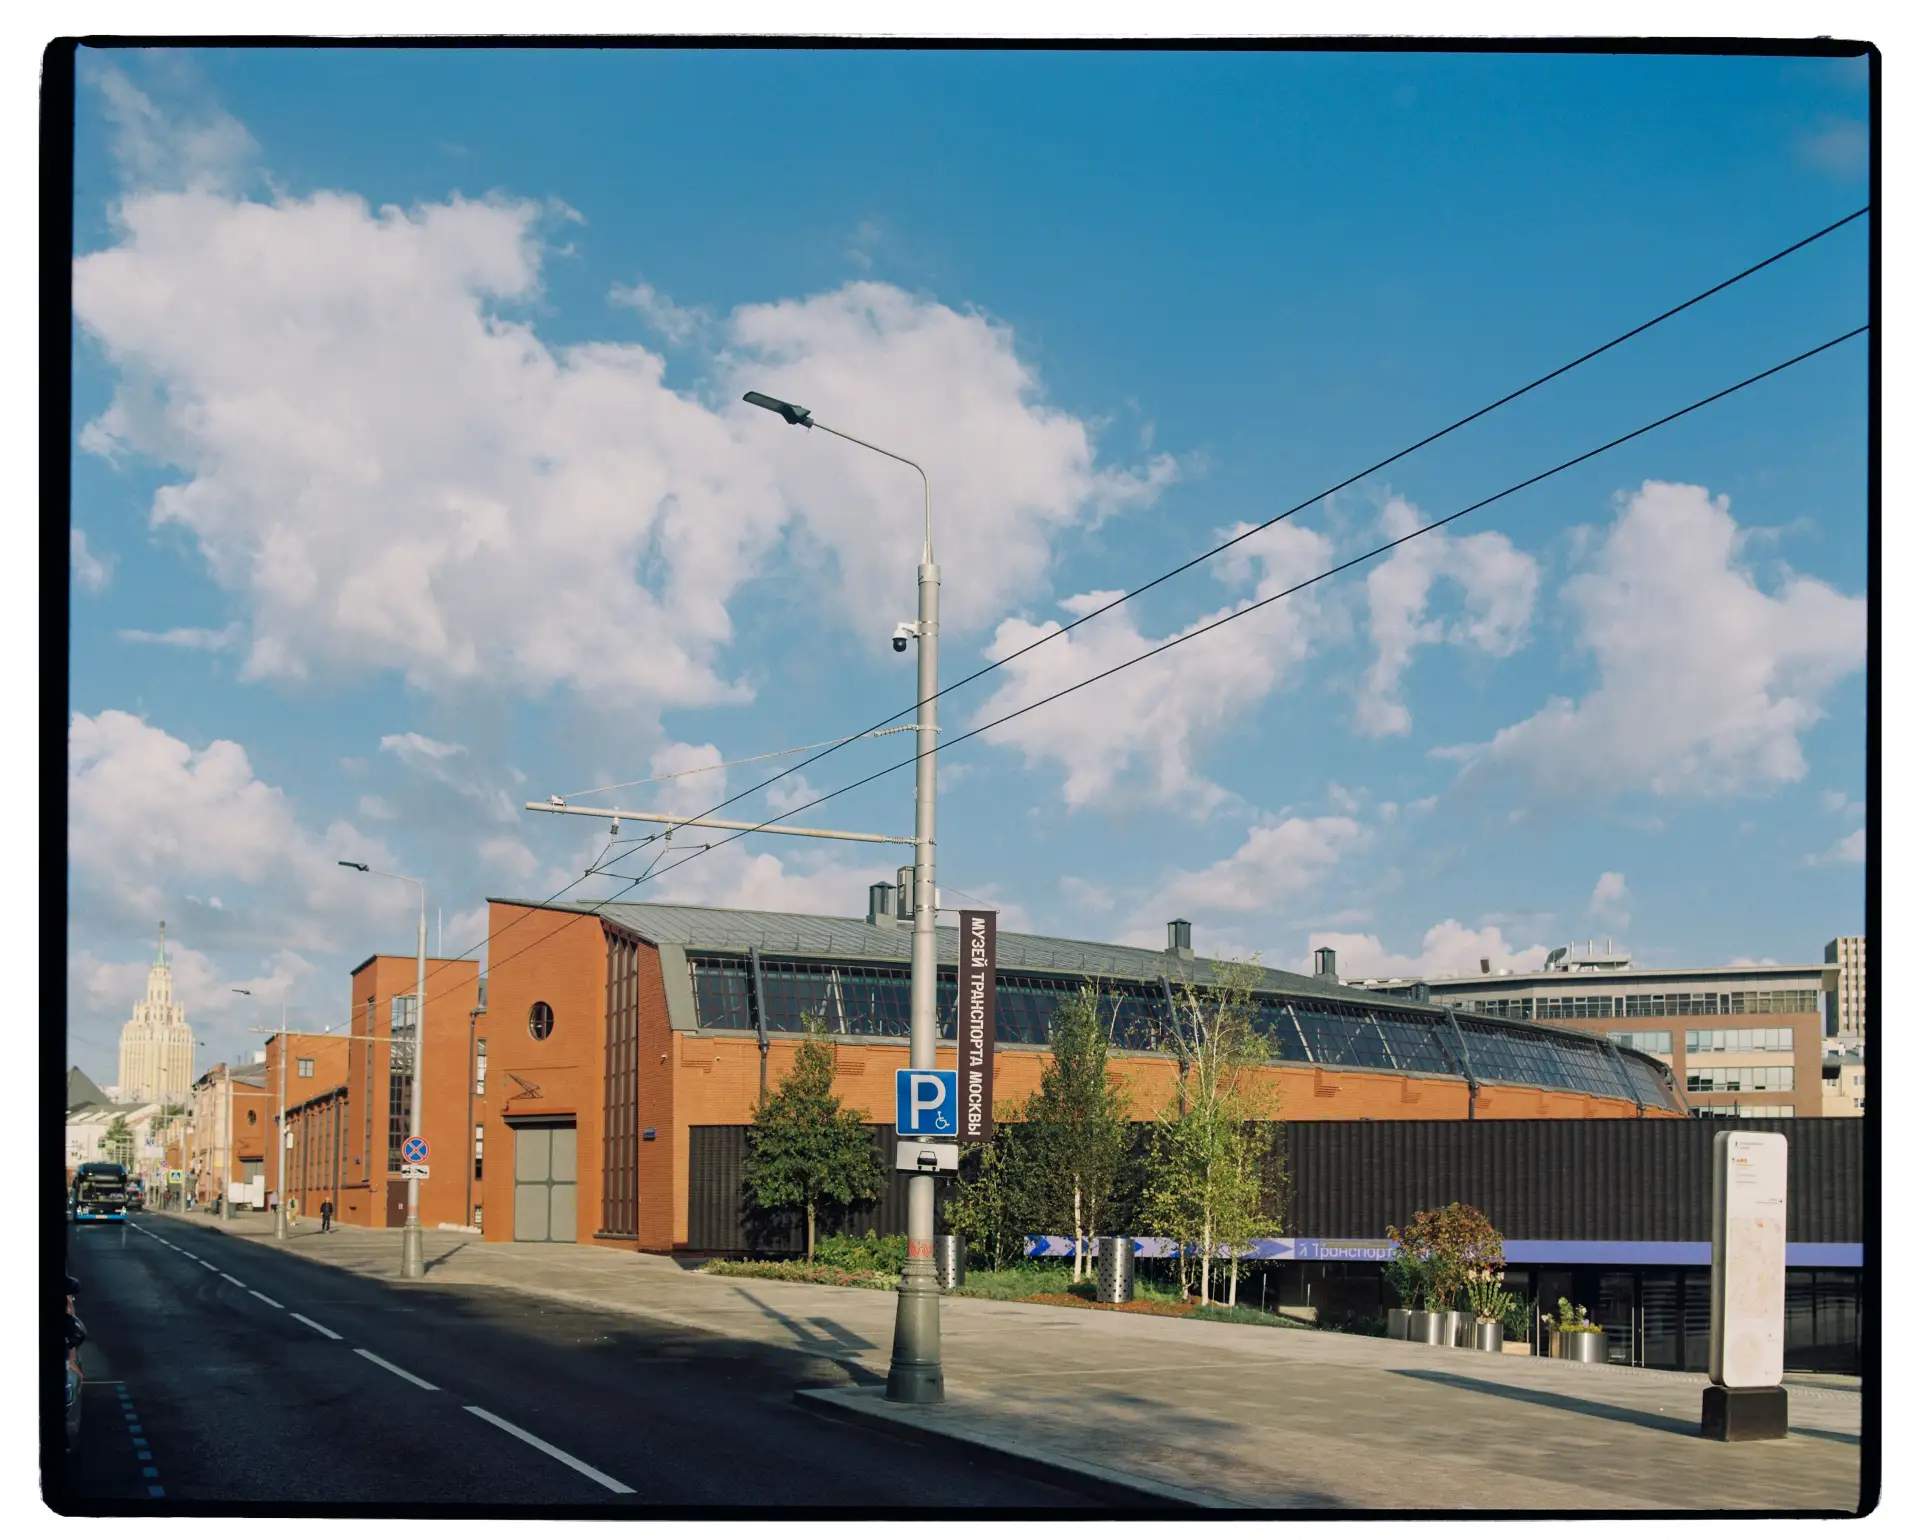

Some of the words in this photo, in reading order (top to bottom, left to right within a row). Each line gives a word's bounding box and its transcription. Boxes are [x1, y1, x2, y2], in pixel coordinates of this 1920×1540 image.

[971, 917, 988, 968] МУЗЕЙ
[969, 972, 985, 1067] ТРАНСПОРТА
[910, 1074, 946, 1130] P
[967, 1071, 983, 1136] МОСКВЫ
[1312, 1243, 1400, 1260] Транспорт
